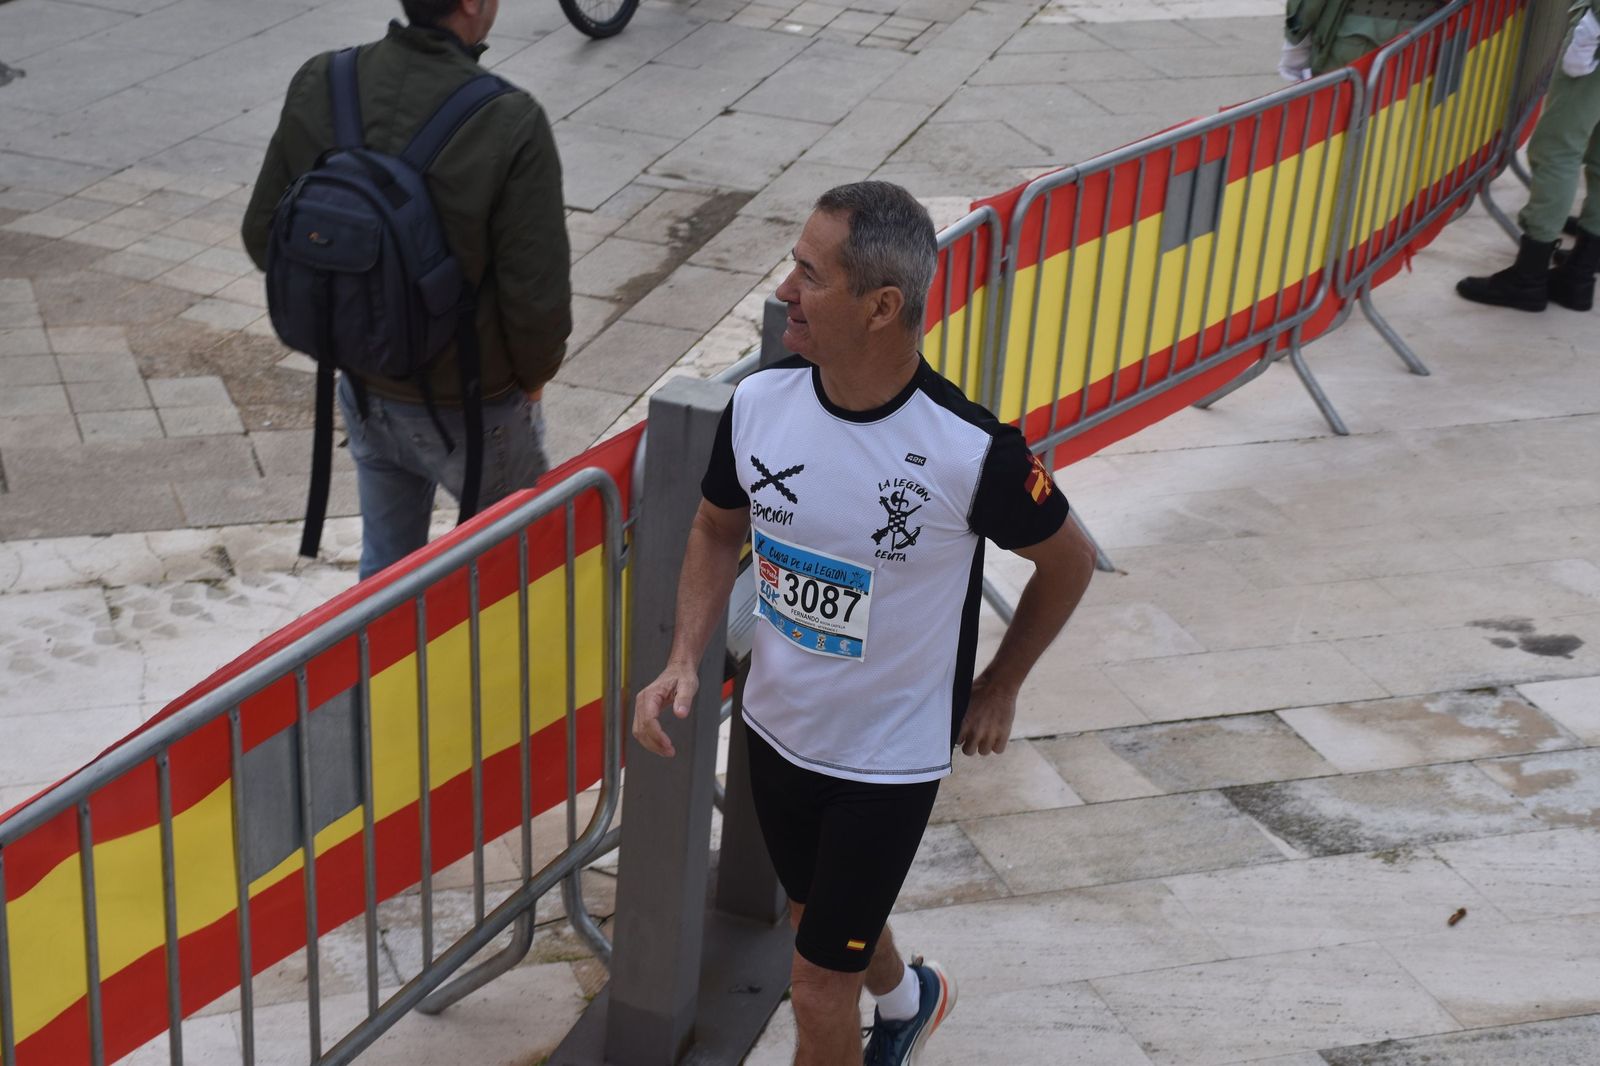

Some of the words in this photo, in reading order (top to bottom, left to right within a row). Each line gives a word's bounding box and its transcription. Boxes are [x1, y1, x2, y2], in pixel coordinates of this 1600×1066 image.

[878, 479, 890, 492] LA
[893, 478, 931, 503] LEGIÓN
[752, 500, 794, 526] EDICIÓN
[875, 549, 906, 562] CEUTA
[783, 573, 862, 623] 3087
[790, 608, 820, 623] FERNANDO
